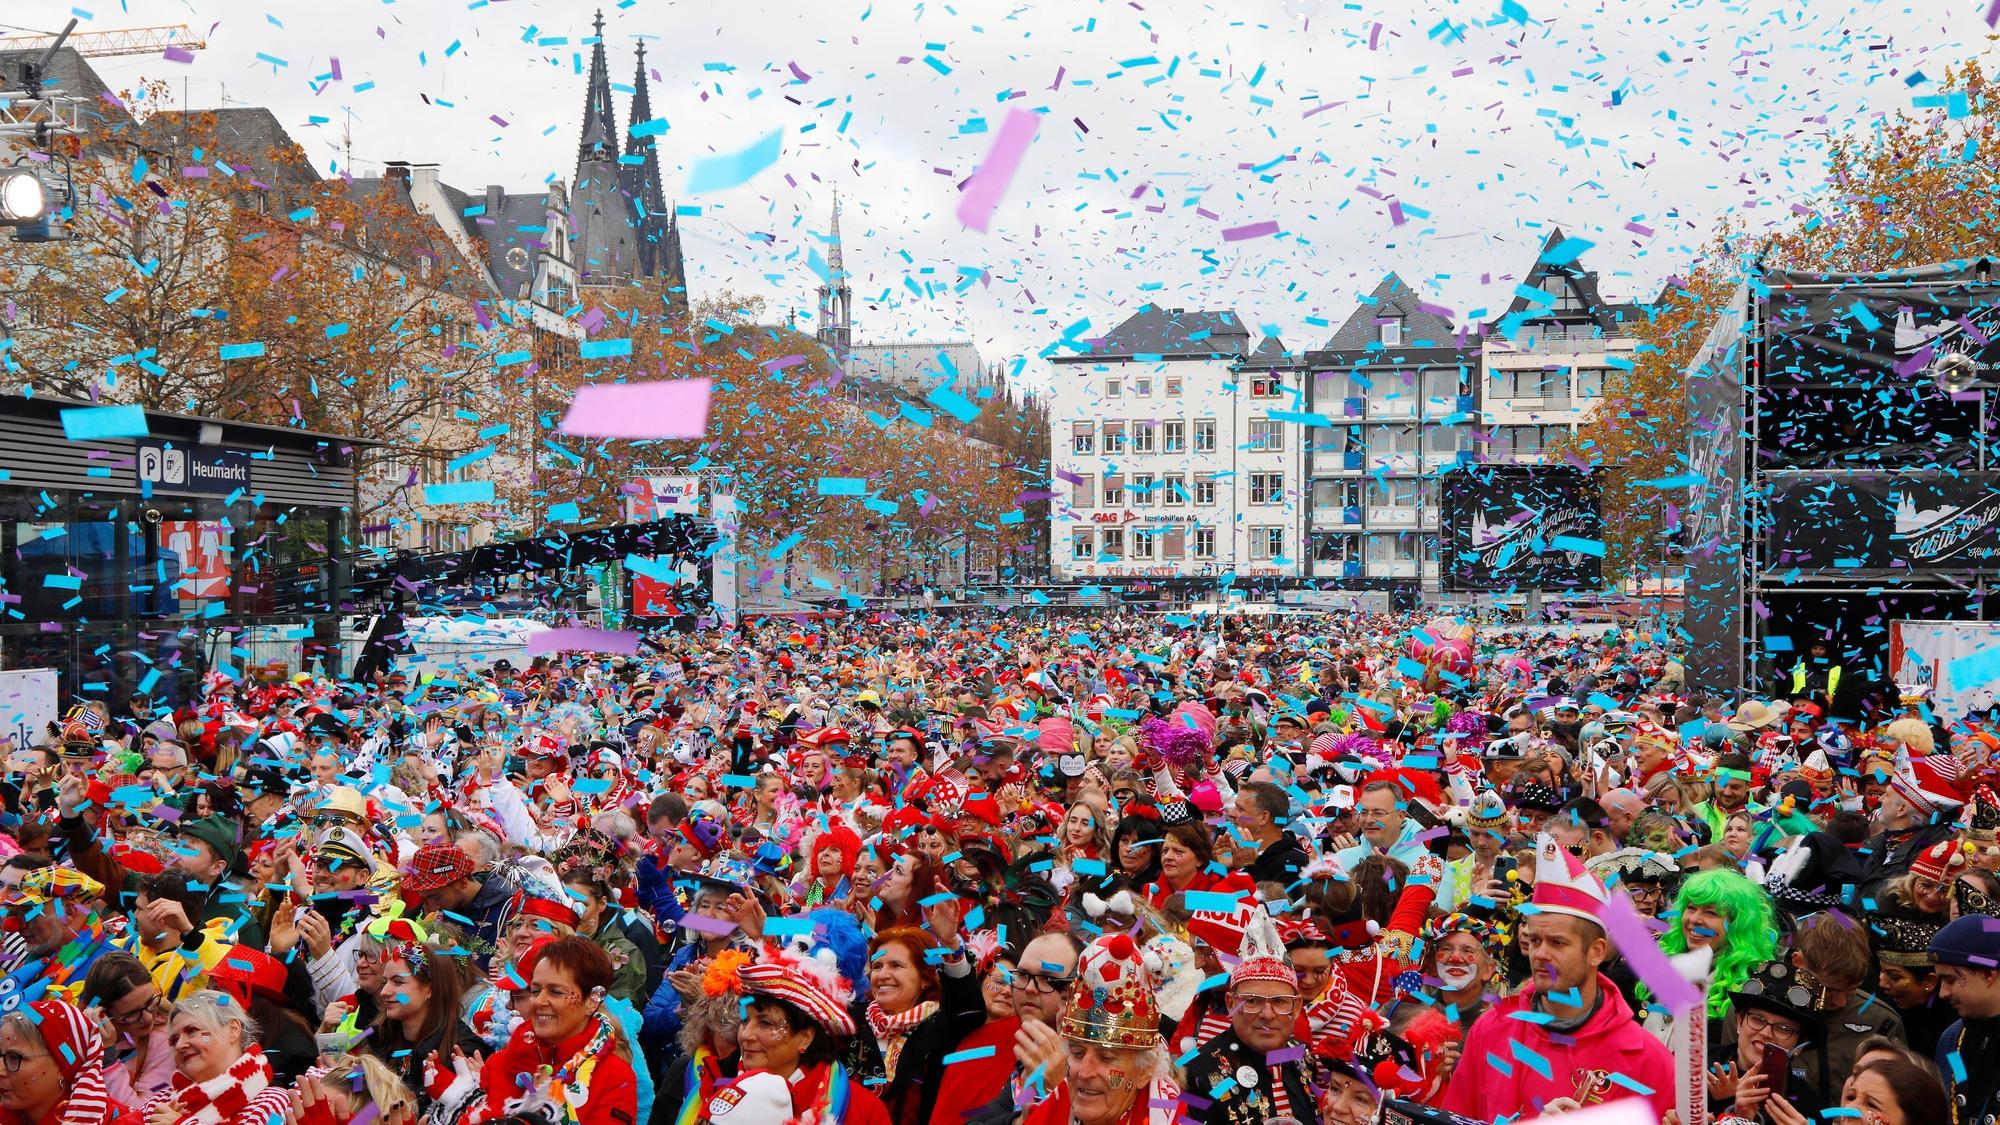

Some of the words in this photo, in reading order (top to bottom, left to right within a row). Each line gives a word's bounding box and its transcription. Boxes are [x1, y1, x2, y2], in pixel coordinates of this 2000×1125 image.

[192, 461, 246, 480] Heumarkt
[1092, 512, 1118, 523] GAG
[1186, 514, 1198, 523] AG
[1250, 567, 1282, 577] HOTEL
